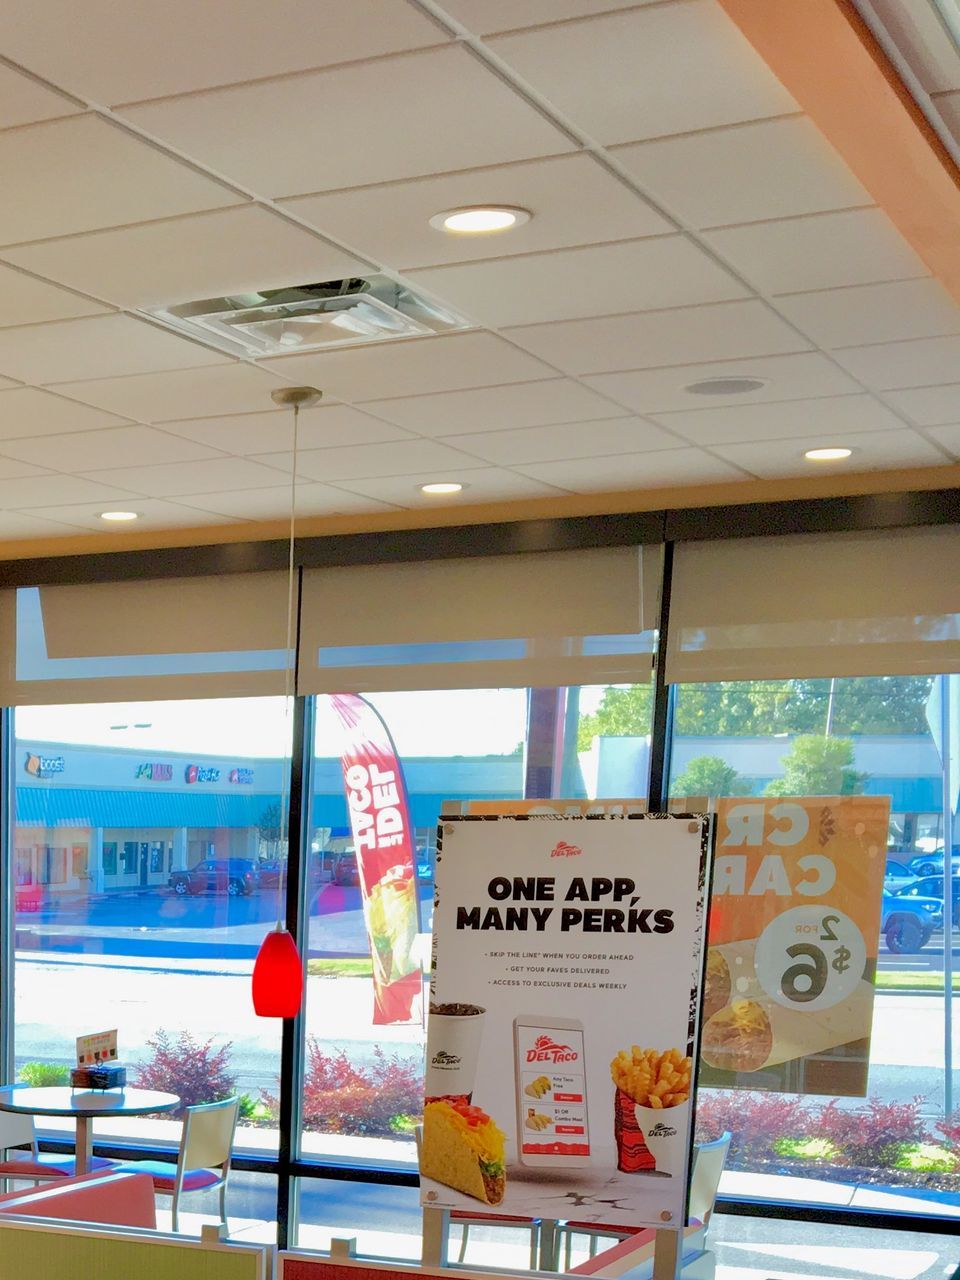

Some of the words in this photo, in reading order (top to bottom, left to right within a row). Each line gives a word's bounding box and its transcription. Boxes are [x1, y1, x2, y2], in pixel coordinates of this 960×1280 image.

[488, 877, 555, 901] ONE
[565, 877, 641, 907] APP,
[456, 907, 553, 931] MANY
[561, 908, 675, 934] PERKS
[526, 1050, 551, 1063] DEL
[551, 1051, 578, 1064] TACO
